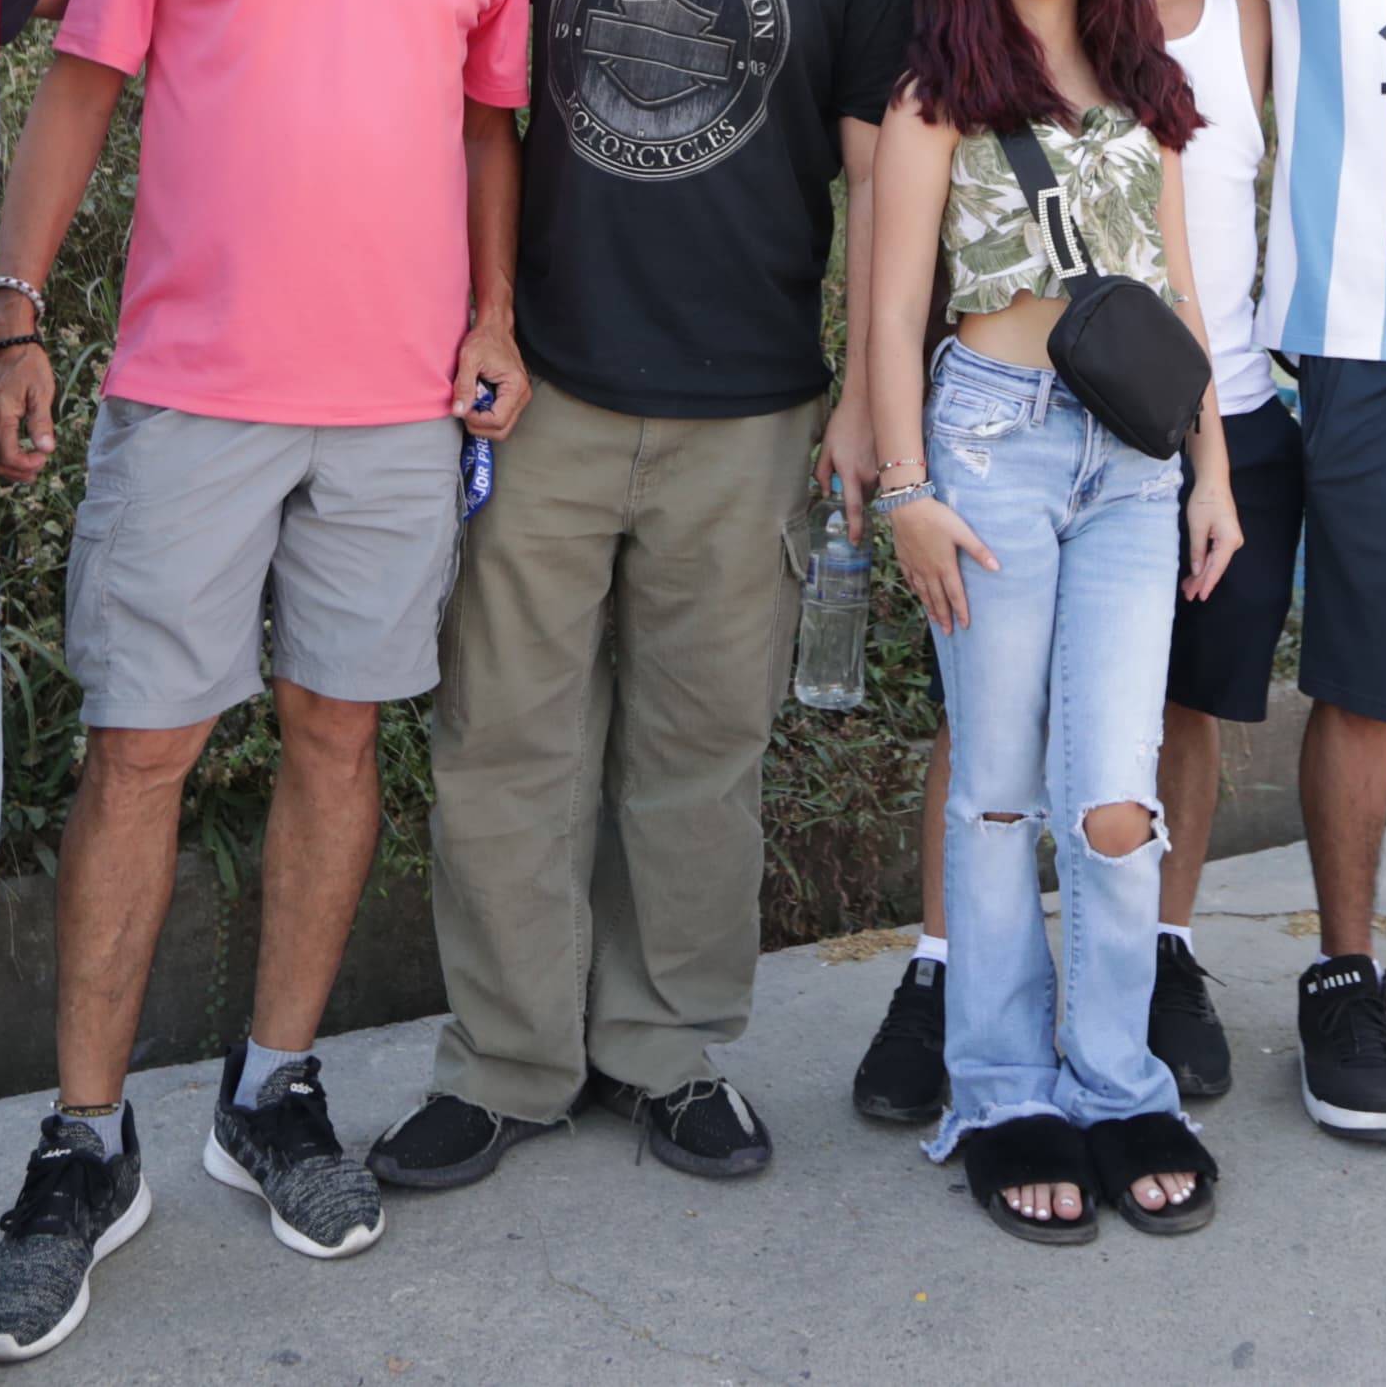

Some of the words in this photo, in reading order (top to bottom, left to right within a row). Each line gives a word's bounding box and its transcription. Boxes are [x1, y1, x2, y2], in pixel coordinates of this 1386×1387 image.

[554, 22, 570, 39] 19
[749, 59, 767, 78] 03
[566, 91, 736, 167] MOTORCYCLES
